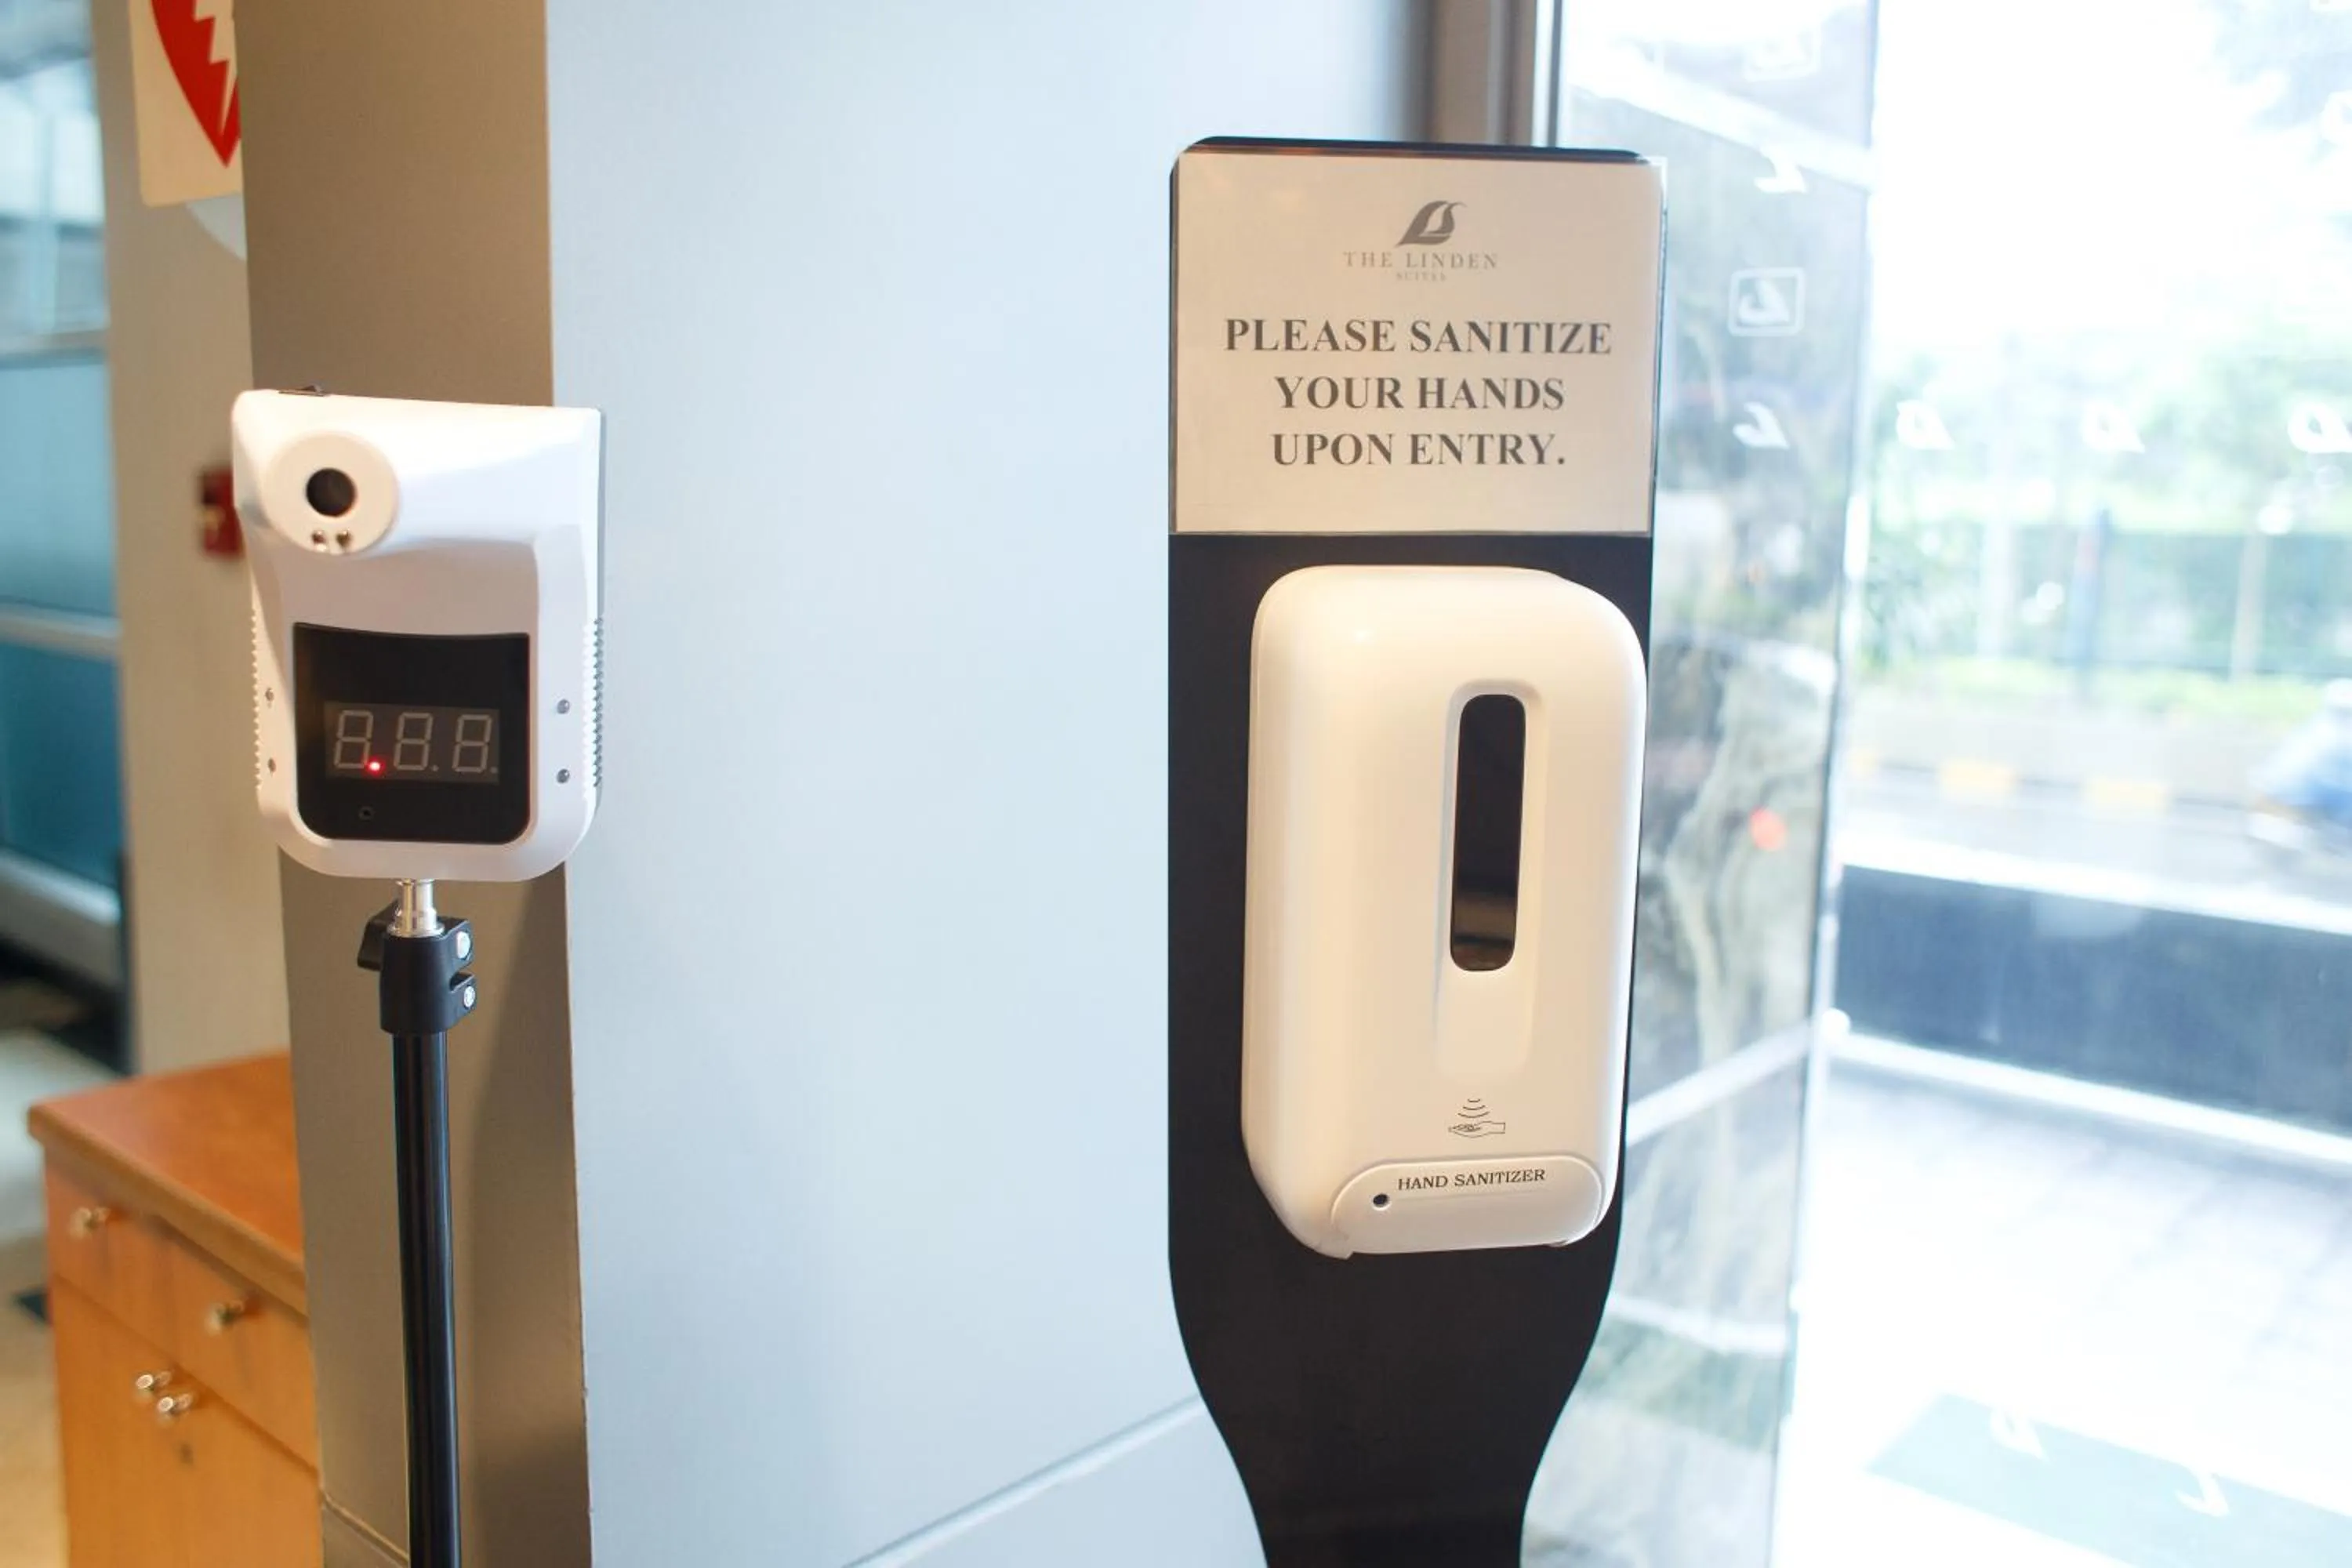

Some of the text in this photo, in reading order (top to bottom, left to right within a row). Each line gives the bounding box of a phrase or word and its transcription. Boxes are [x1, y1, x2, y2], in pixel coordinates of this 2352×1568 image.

[1343, 251, 1497, 270] THE LINDEN
[1395, 271, 1446, 282] SUITES
[1225, 318, 1612, 355] PLEASE SANITIZE
[1275, 376, 1565, 411] YOUR HANDS
[1272, 433, 1566, 466] UPON ENTRY.
[1398, 1169, 1546, 1191] HAND SANITIZER
